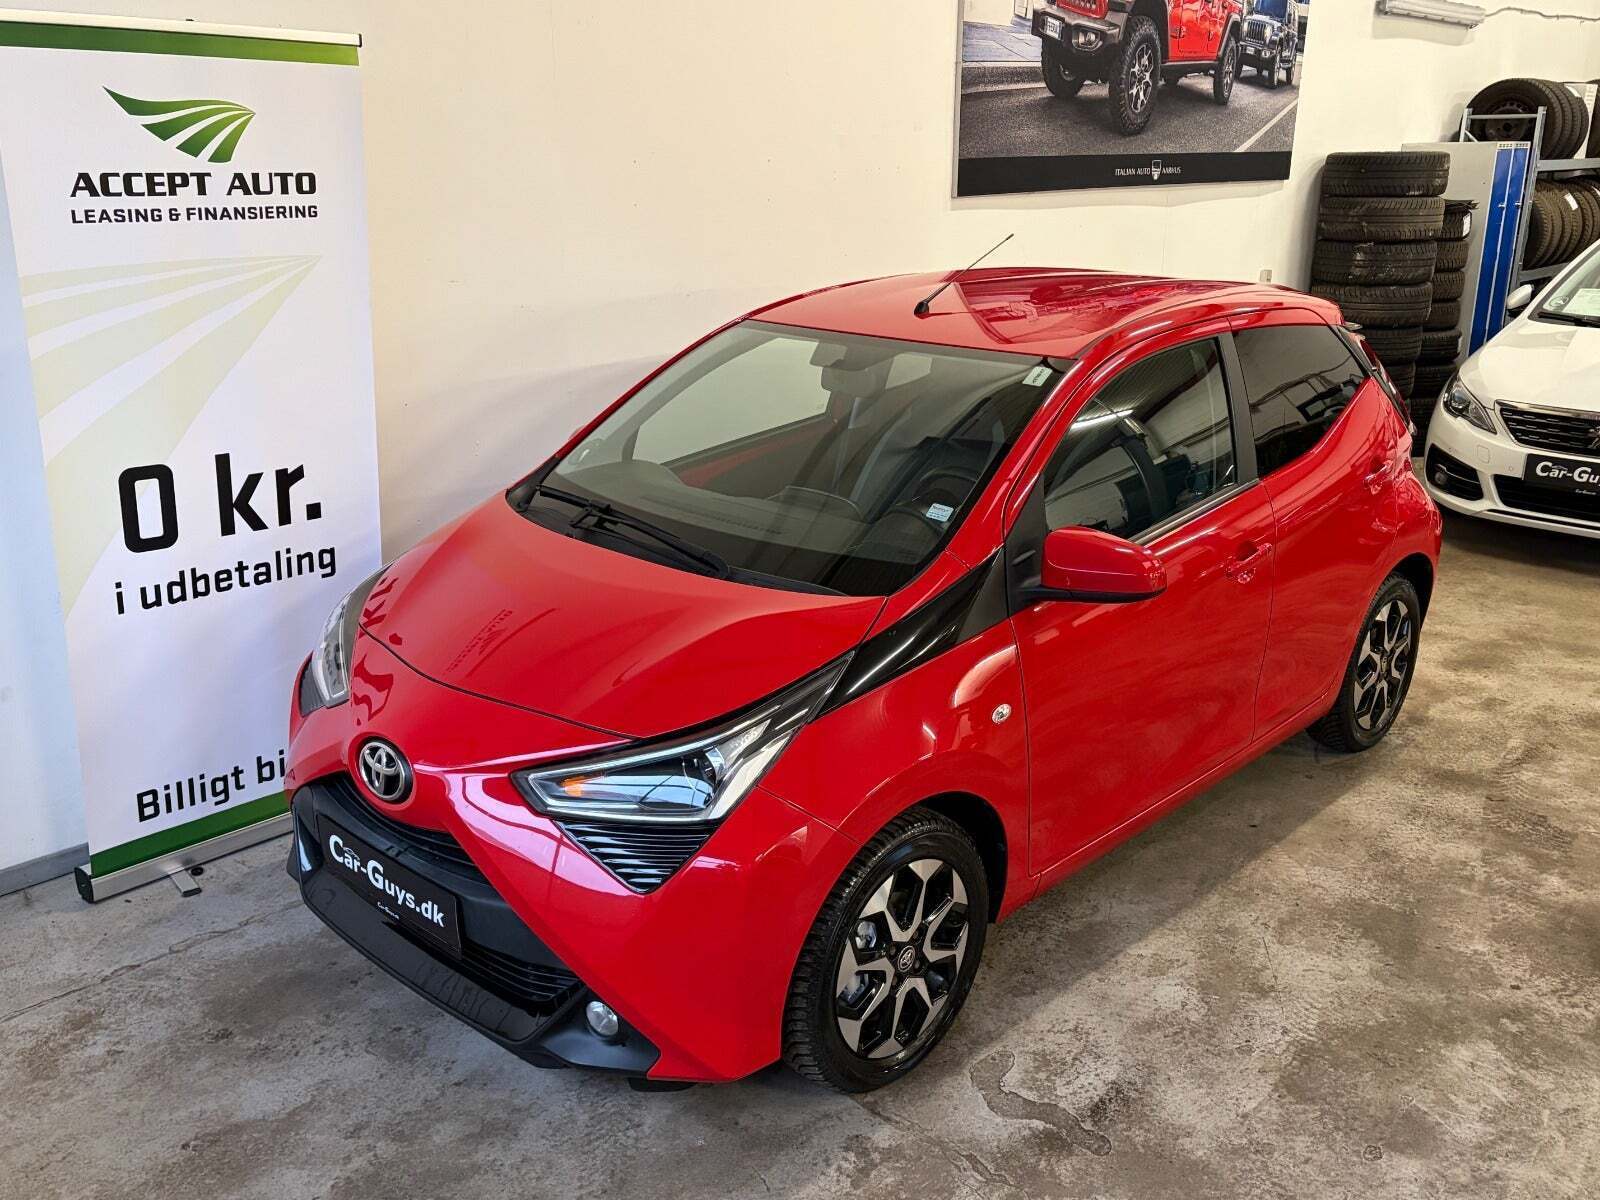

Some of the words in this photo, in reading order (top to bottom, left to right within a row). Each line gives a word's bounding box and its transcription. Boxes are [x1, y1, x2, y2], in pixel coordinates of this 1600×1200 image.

[70, 172, 212, 198] ACCEPT
[226, 172, 317, 196] AUTO
[1114, 168, 1136, 176] ITALIAN
[1136, 167, 1151, 176] AUTO
[70, 208, 163, 224] LEASING
[168, 207, 181, 222] &
[185, 205, 318, 221] FINANSIERING
[214, 452, 322, 537] kr.
[1535, 461, 1600, 487] Car-Gu
[114, 581, 125, 615] i
[139, 546, 337, 610] udbetaling
[136, 765, 246, 823] Billigt
[256, 748, 287, 785] bi
[329, 834, 446, 928] Car-Guys.dk
